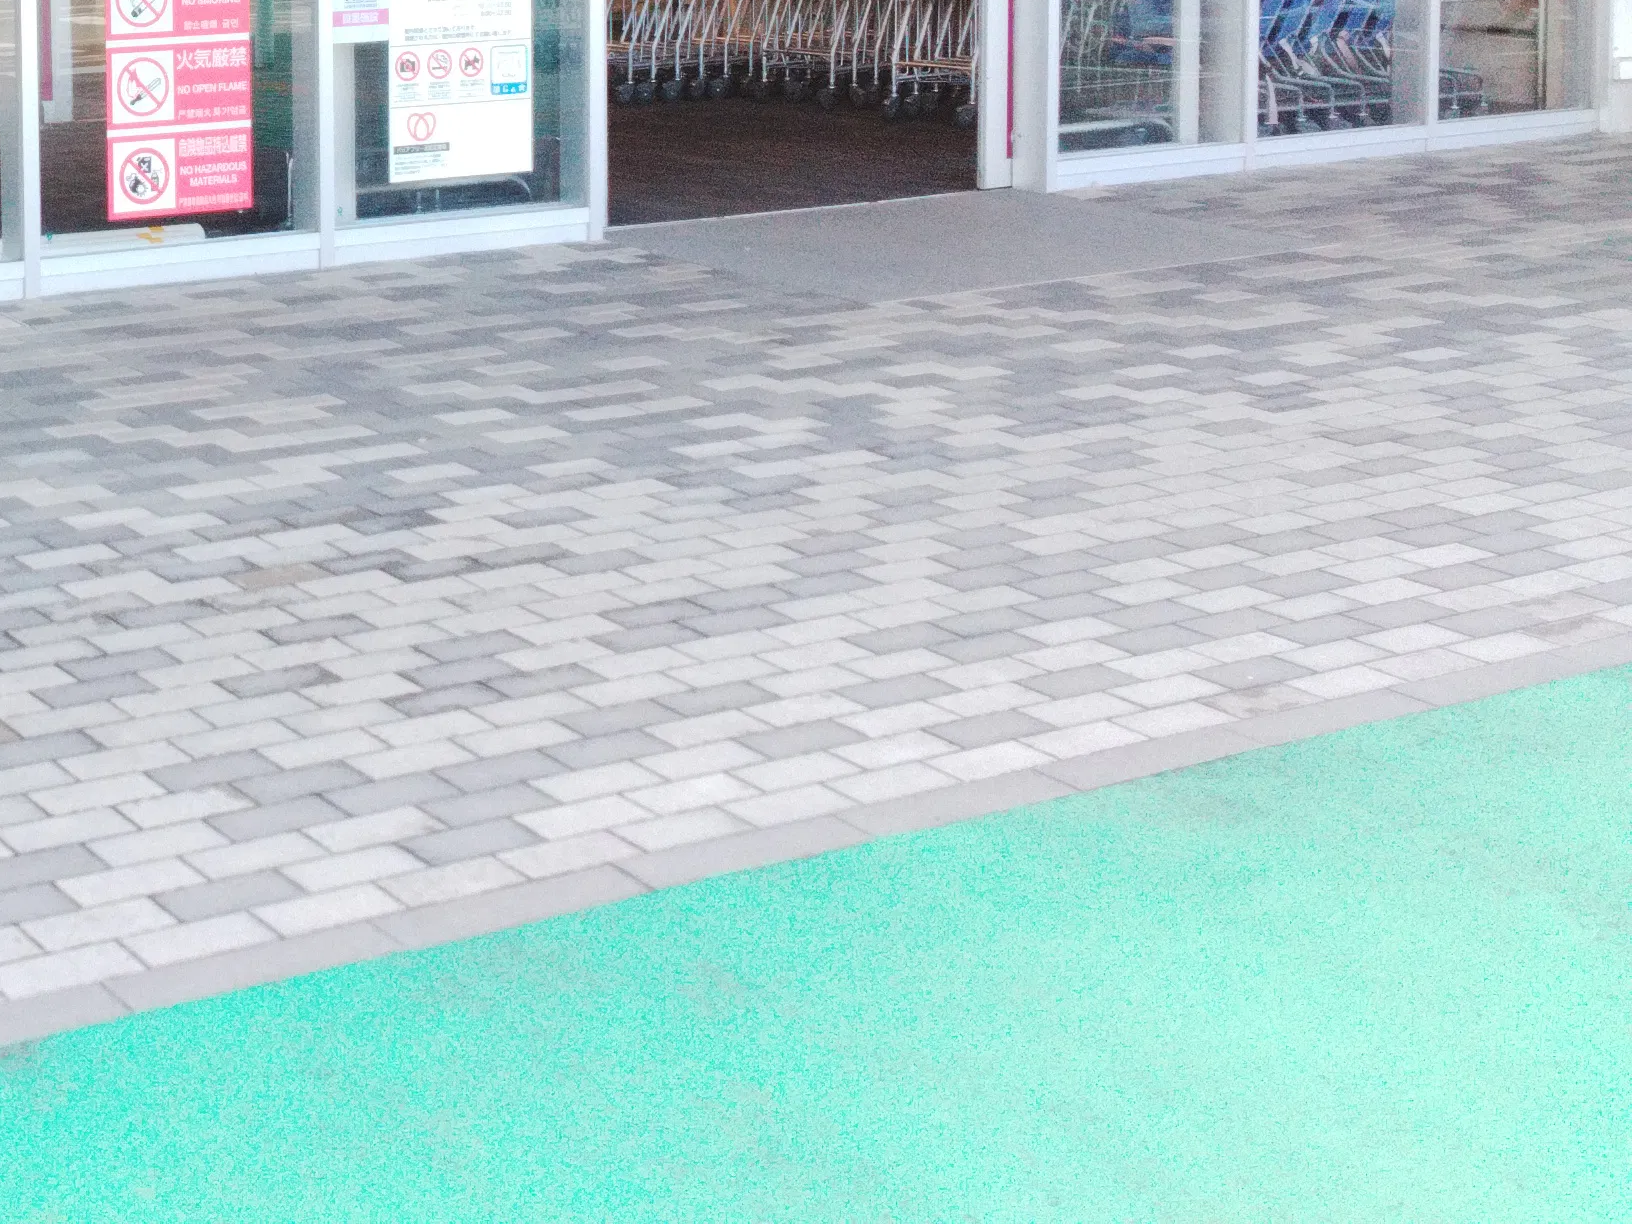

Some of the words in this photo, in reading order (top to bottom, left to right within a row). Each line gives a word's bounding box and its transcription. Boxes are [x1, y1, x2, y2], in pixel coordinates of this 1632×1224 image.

[176, 46, 247, 70] 火気厳禁
[178, 84, 190, 95] NO
[192, 83, 216, 93] OPEN
[218, 81, 247, 92] FLAME
[179, 166, 193, 176] NO
[194, 161, 247, 174] HAZARDOUS
[189, 174, 238, 187] MATERIALS
